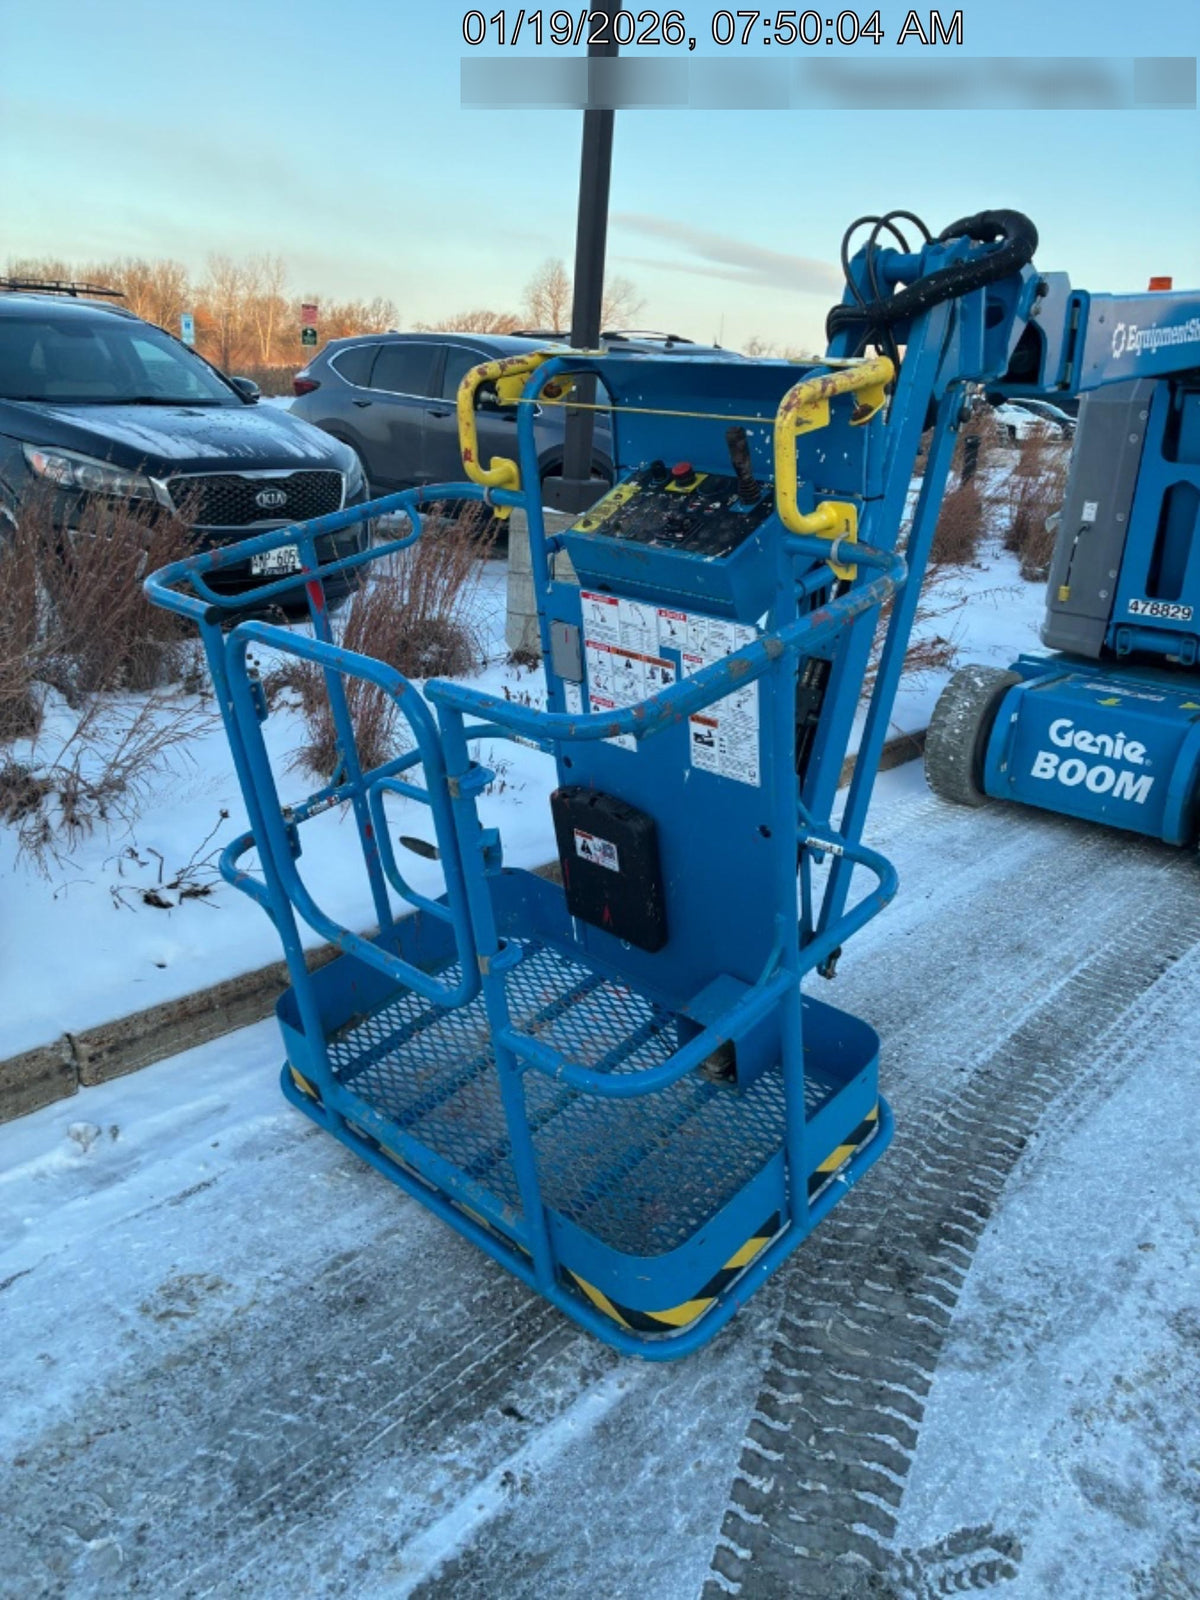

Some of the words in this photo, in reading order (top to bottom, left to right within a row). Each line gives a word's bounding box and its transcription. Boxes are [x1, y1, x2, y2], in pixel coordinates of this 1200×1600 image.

[262, 493, 285, 505] KIA
[1129, 600, 1192, 620] 478829
[1049, 718, 1148, 765] Genie
[1030, 750, 1155, 804] BOOM
